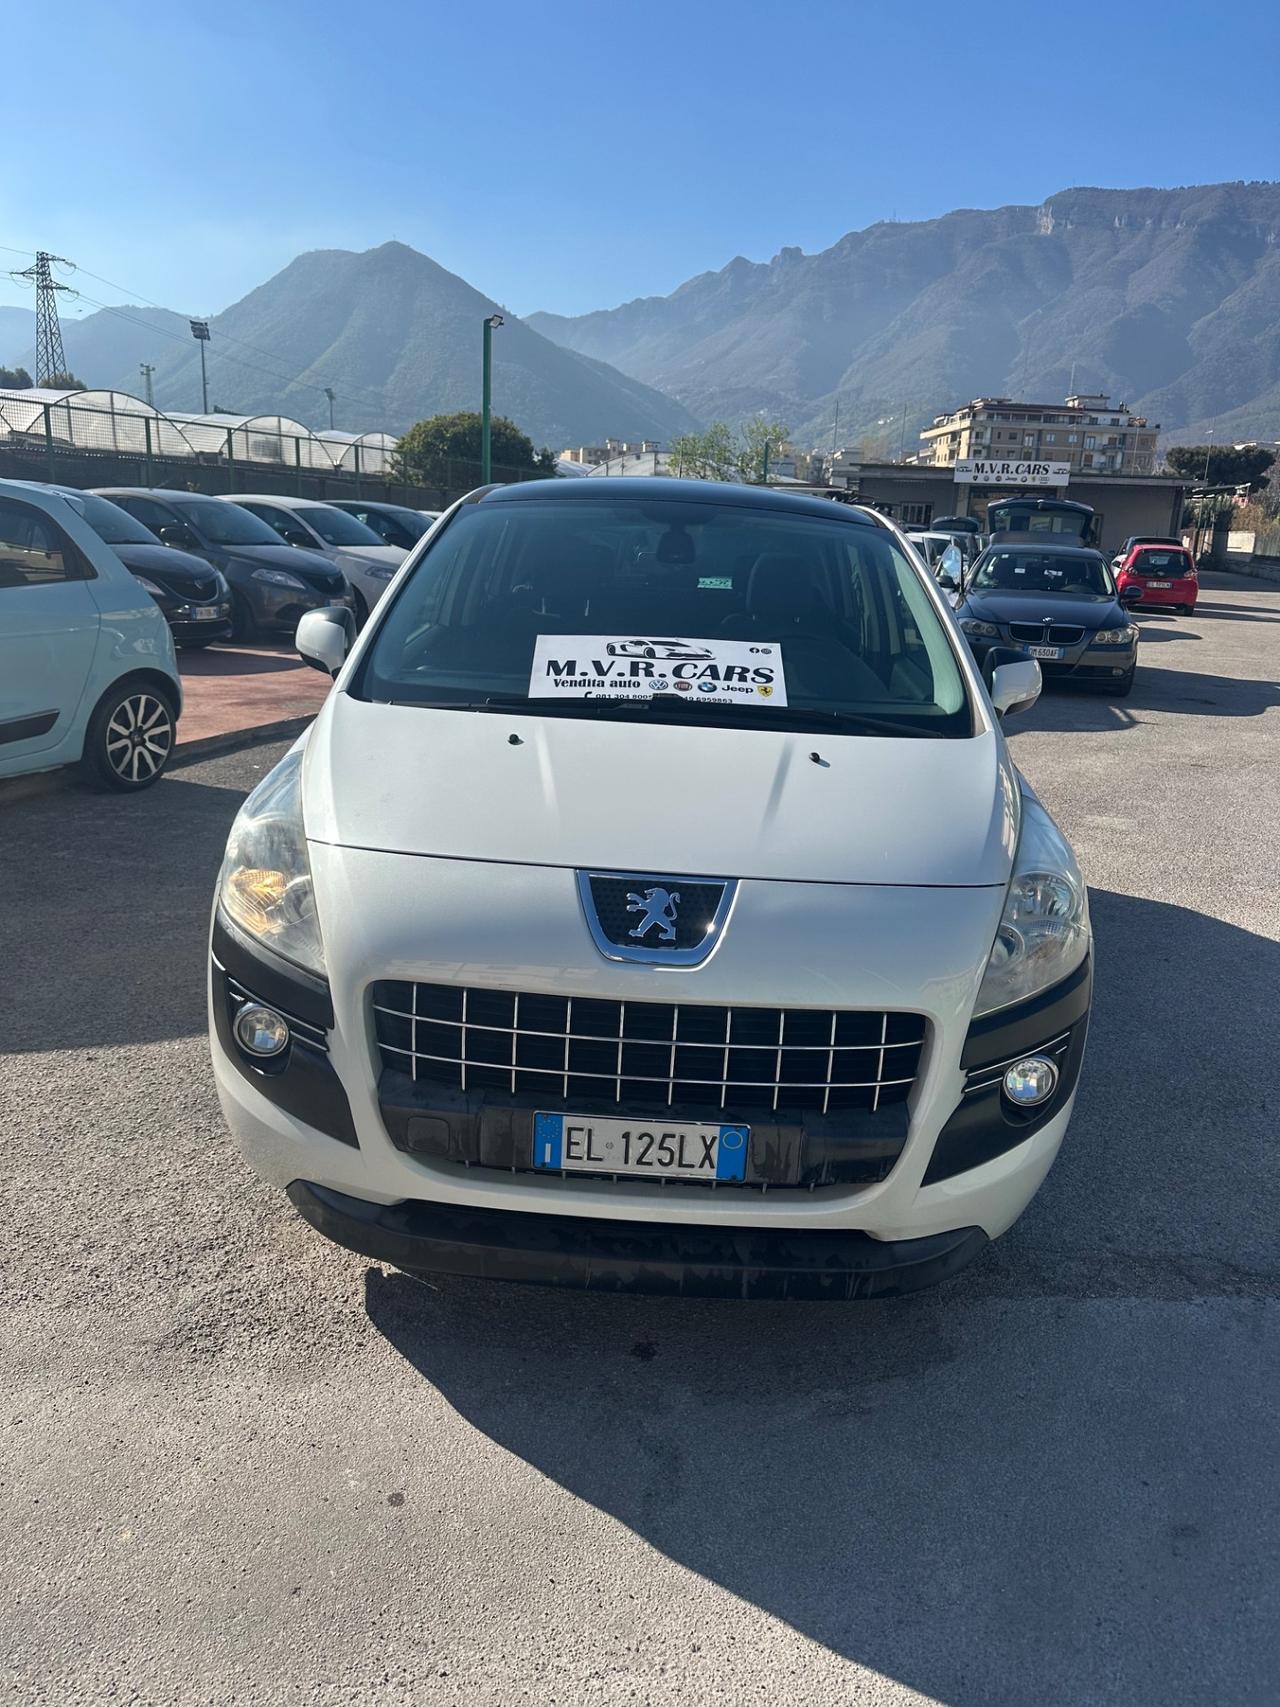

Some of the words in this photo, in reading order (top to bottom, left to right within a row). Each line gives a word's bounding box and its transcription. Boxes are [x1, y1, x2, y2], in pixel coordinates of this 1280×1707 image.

[553, 678, 605, 688] Vendita
[609, 679, 641, 688] auto
[722, 684, 754, 694] Jeep
[566, 1127, 603, 1162] EL
[621, 1131, 718, 1169] 125LX
